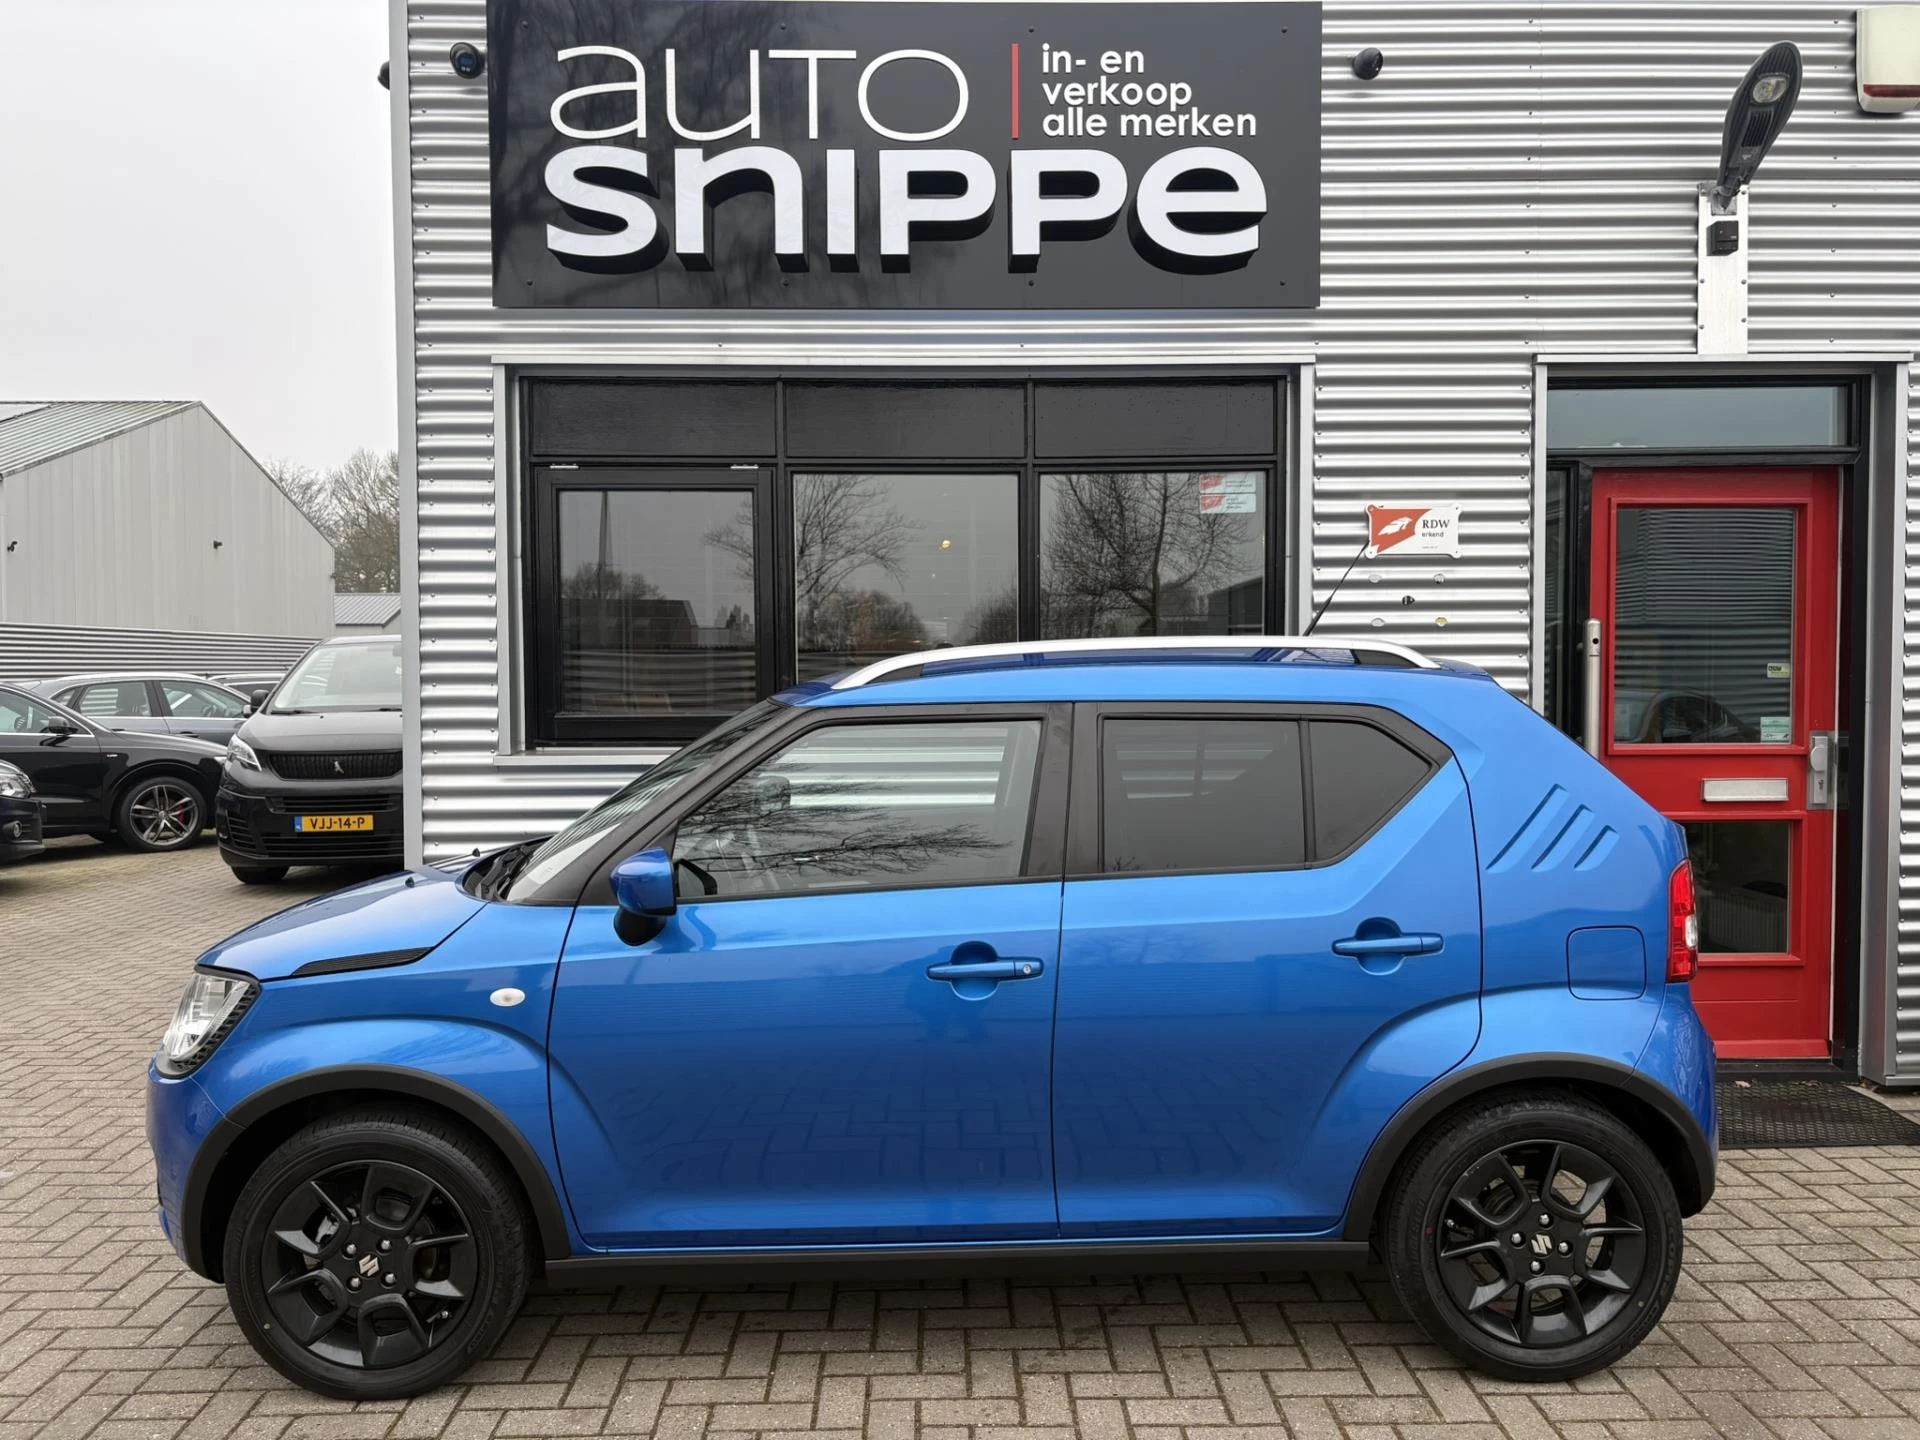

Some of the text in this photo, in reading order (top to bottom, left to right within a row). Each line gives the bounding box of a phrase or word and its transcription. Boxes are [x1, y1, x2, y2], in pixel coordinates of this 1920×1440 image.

[1041, 42, 1145, 74] in- en
[1041, 75, 1193, 113] verkoop
[1042, 106, 1257, 137] alle merken
[1421, 519, 1451, 529] RDW
[1421, 530, 1445, 538] erkend
[310, 817, 366, 830] VJJ-14-P
